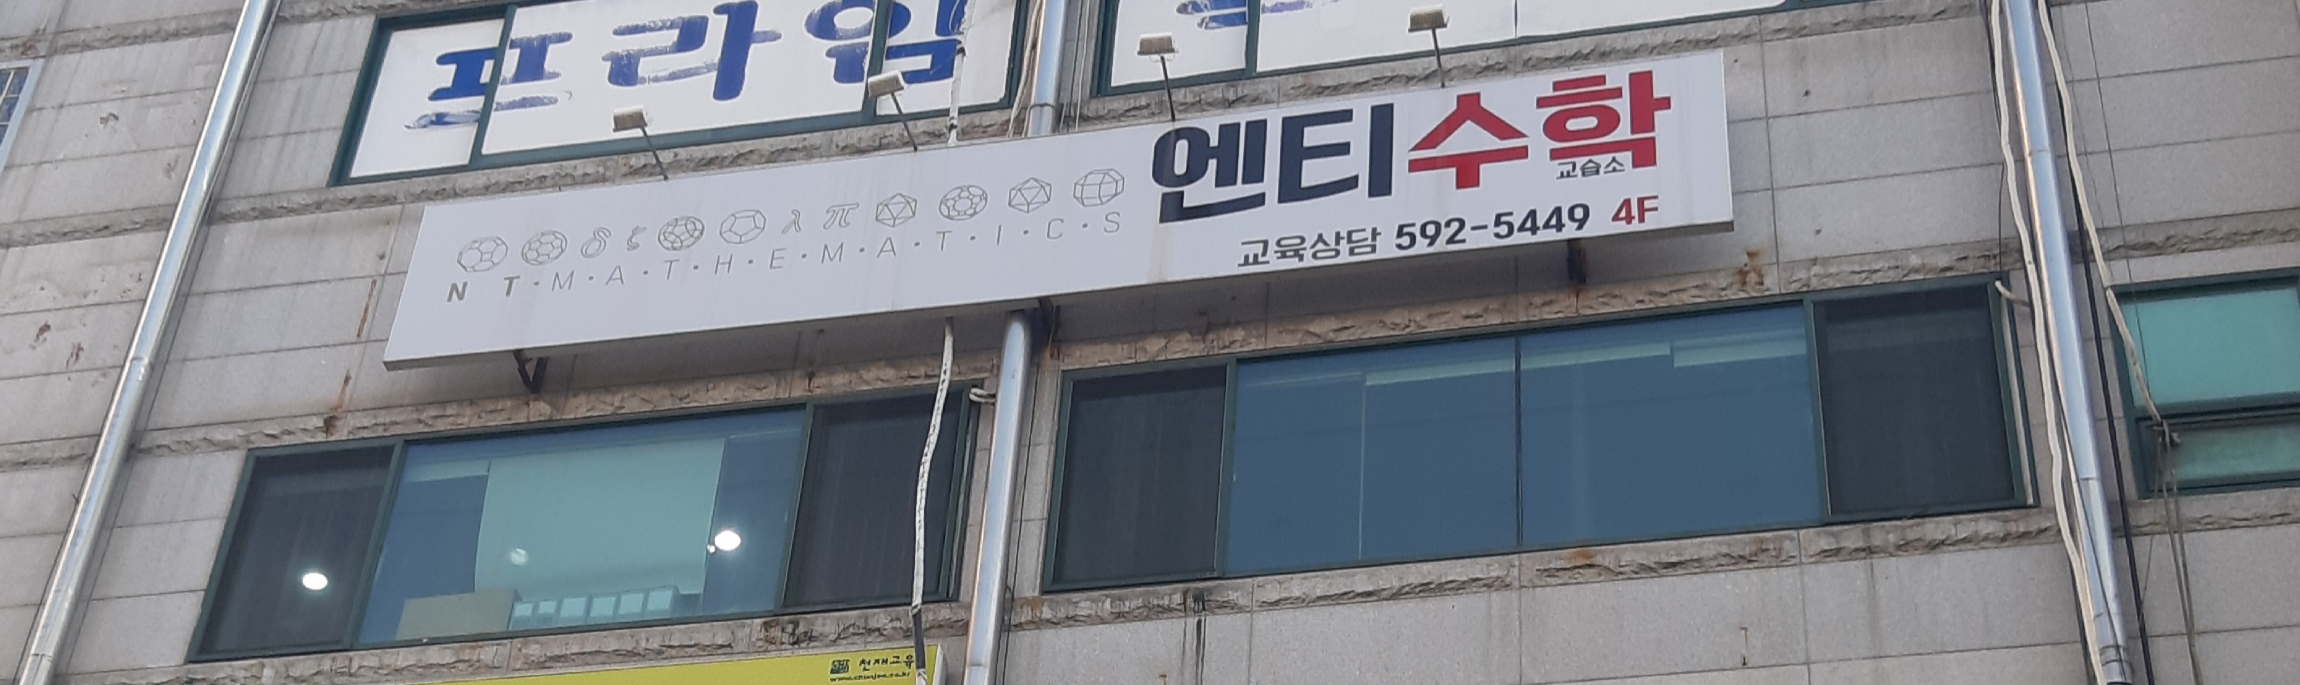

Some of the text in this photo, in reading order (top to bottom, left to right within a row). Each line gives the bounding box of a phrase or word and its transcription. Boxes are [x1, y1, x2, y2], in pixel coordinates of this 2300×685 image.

[404, 0, 968, 129] 프라임
[1152, 70, 1672, 223] 엔티수학
[1555, 156, 1627, 180] 교습소
[1237, 195, 1660, 267] 교육상담 592-5449 4F
